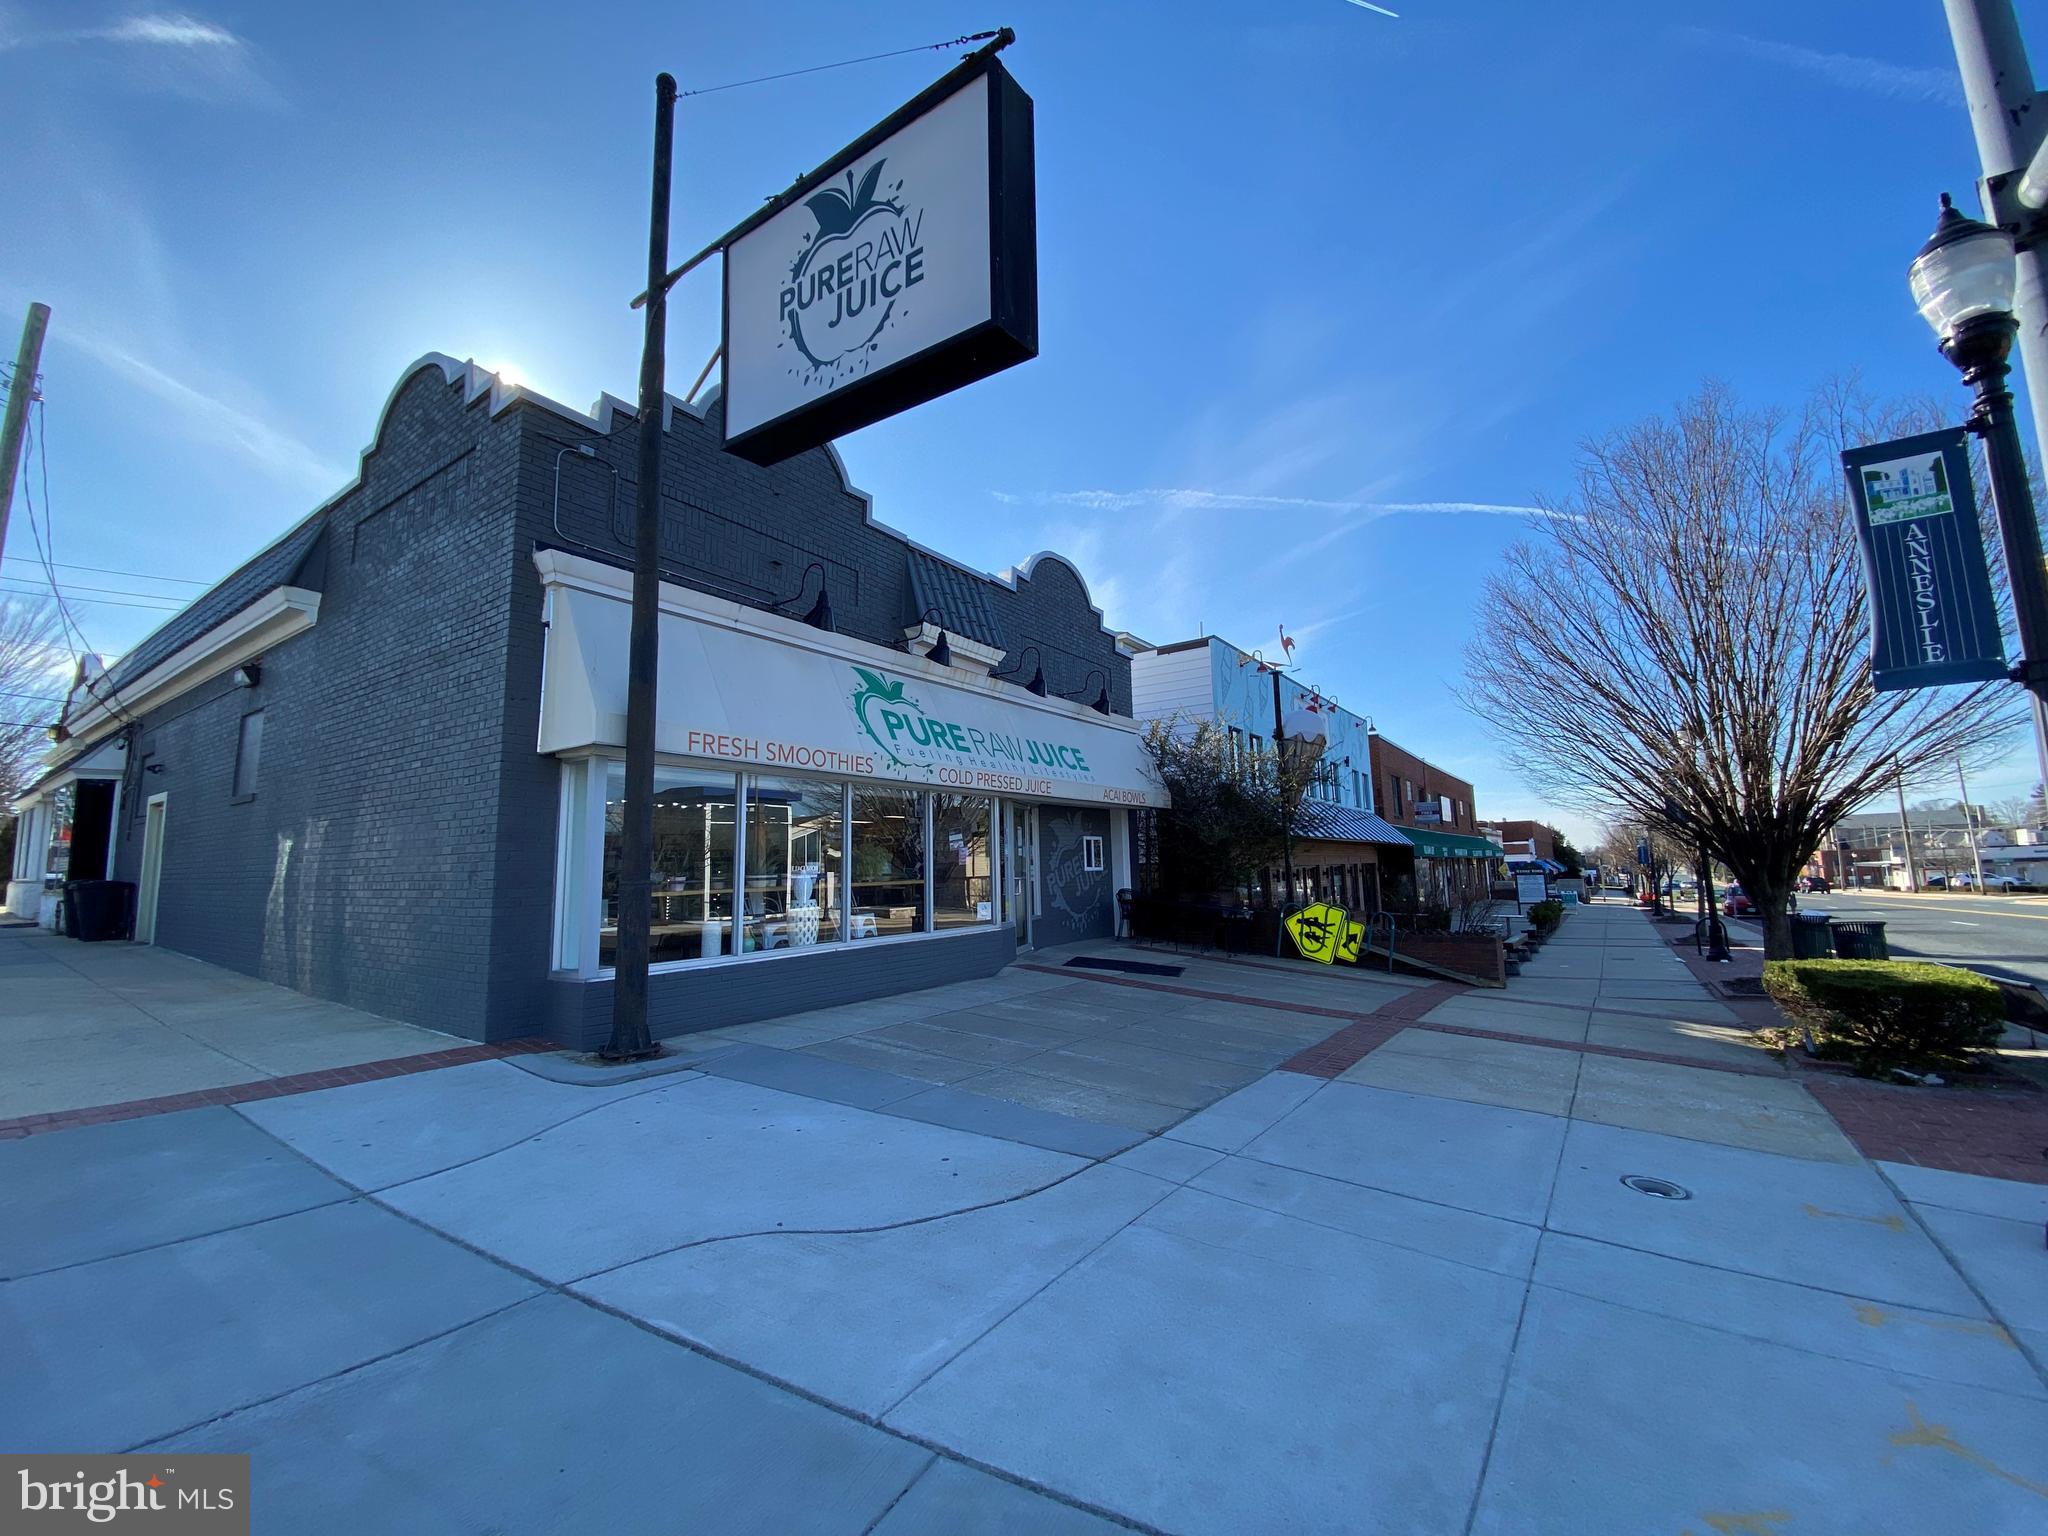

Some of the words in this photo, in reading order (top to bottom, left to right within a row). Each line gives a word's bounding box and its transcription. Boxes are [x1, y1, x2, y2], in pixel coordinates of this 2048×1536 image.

[828, 246, 924, 329] JUICE
[1904, 523, 1945, 663] ANNESLIE
[688, 731, 759, 759] FRESH
[766, 742, 874, 774] SMOOTHIES
[894, 743, 963, 766] Fueling
[968, 755, 1027, 776] Healthy
[1025, 739, 1091, 772] JUICE
[939, 767, 974, 785] COLD
[976, 772, 1023, 791] PRESSED
[1025, 779, 1052, 794] JUICE
[1103, 789, 1120, 801] ACAI
[1122, 791, 1146, 804] BOWLS
